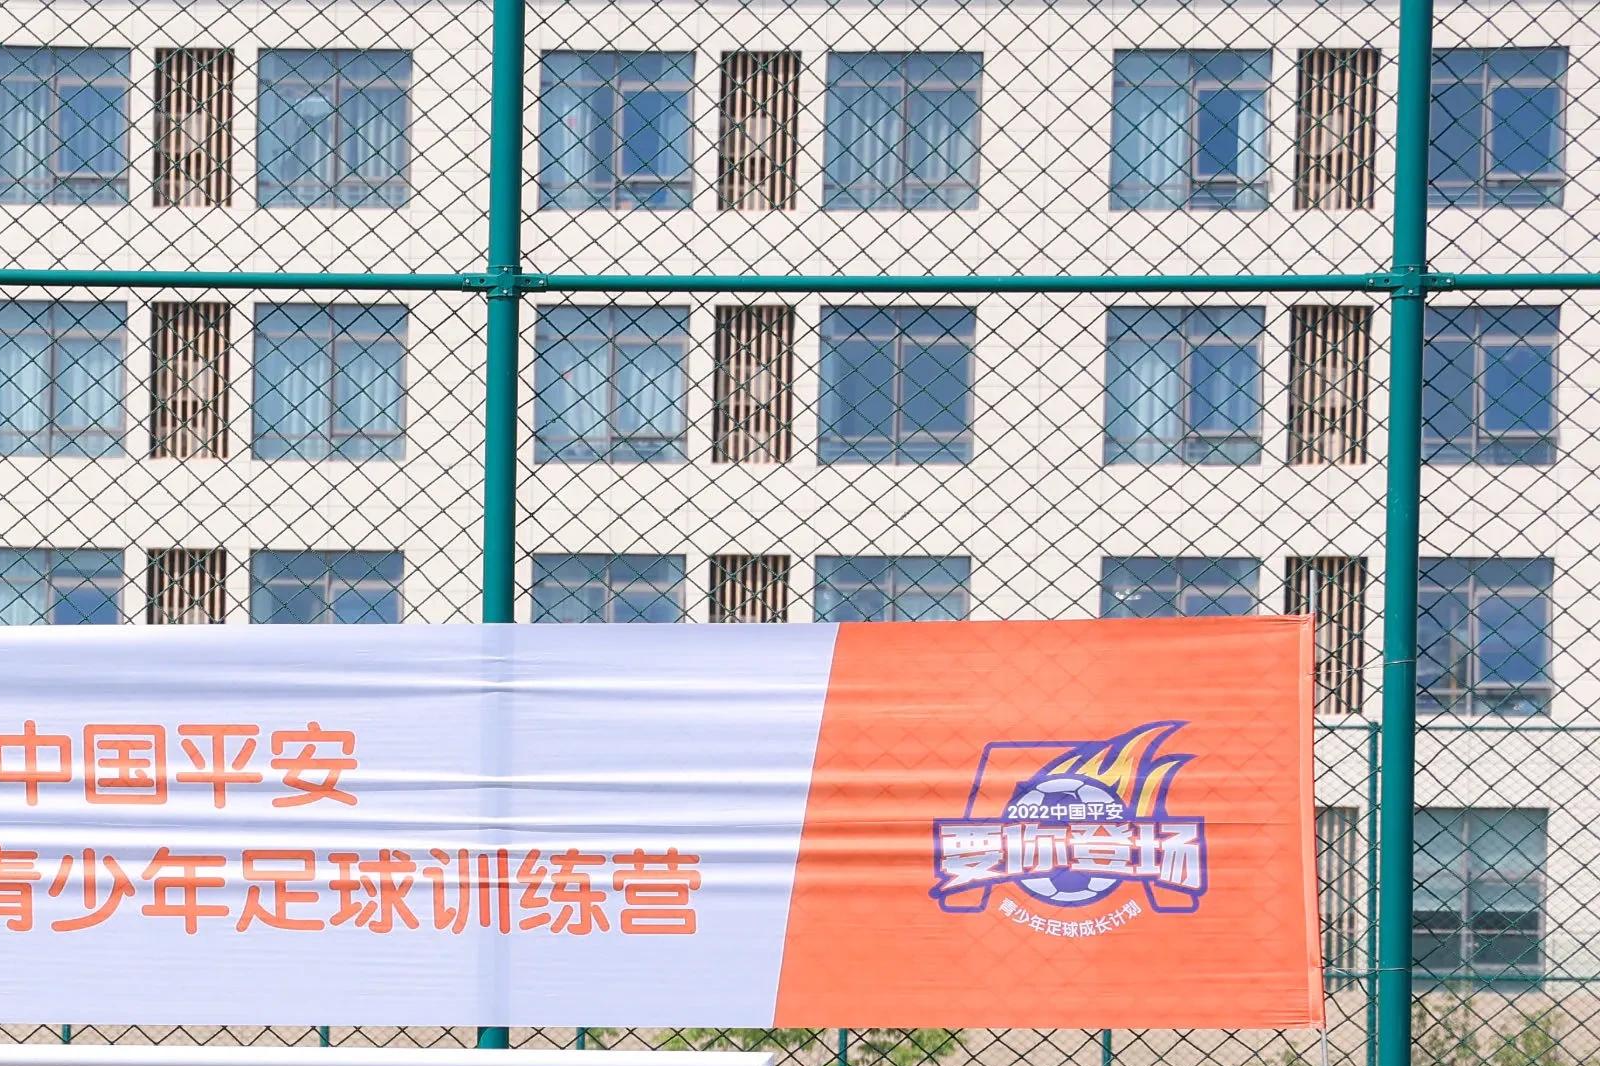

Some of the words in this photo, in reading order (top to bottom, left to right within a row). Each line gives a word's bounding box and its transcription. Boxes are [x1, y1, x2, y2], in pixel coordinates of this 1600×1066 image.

[1007, 803, 1124, 820] 2022中国平安
[940, 822, 1201, 889] 要你登场
[997, 897, 1143, 938] 青少年足球成长计划
